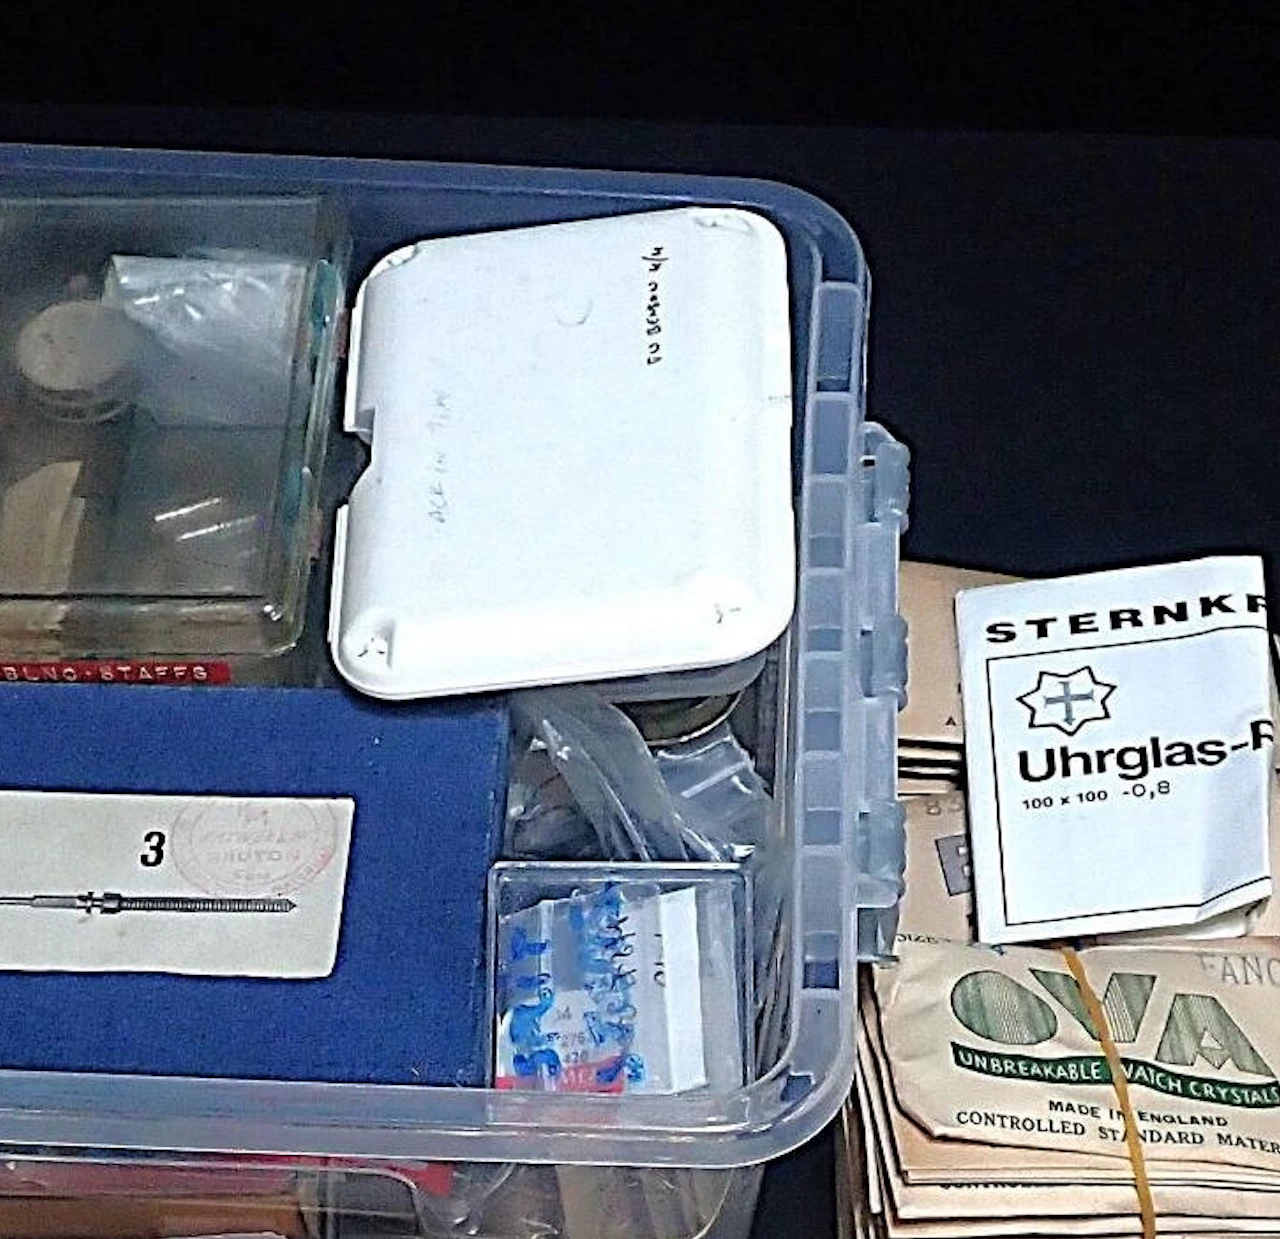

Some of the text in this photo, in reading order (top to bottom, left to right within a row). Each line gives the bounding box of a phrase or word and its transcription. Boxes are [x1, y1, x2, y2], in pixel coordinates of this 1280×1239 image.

[1022, 796, 1053, 811] 100
[1077, 789, 1108, 804] 100
[958, 1052, 1103, 1081] UNBREAKABLE
[956, 1110, 1086, 1137] CONTROLLED
[1048, 1099, 1102, 1120] MADE
[1138, 1112, 1229, 1128] ENGLAND
